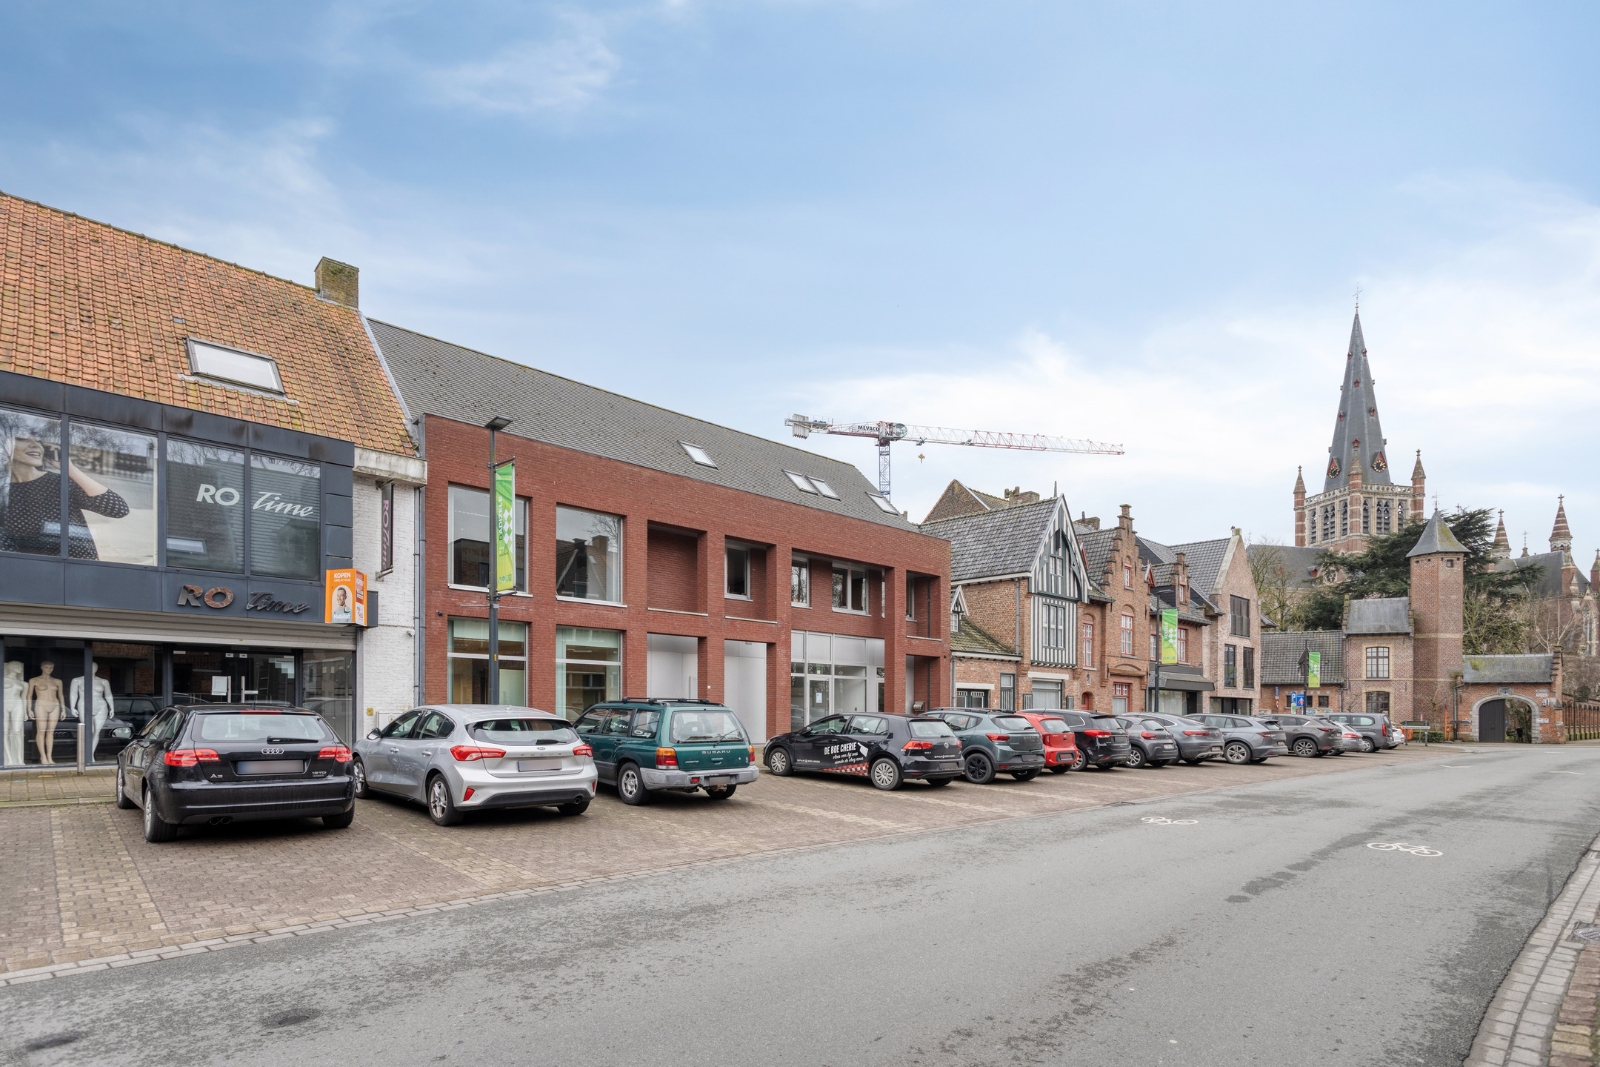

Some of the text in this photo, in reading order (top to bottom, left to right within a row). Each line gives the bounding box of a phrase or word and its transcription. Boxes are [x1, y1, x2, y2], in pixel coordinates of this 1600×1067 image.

[196, 483, 314, 517] RO Time
[382, 499, 389, 528] RO
[177, 584, 310, 613] RO Time
[824, 746, 831, 756] DE
